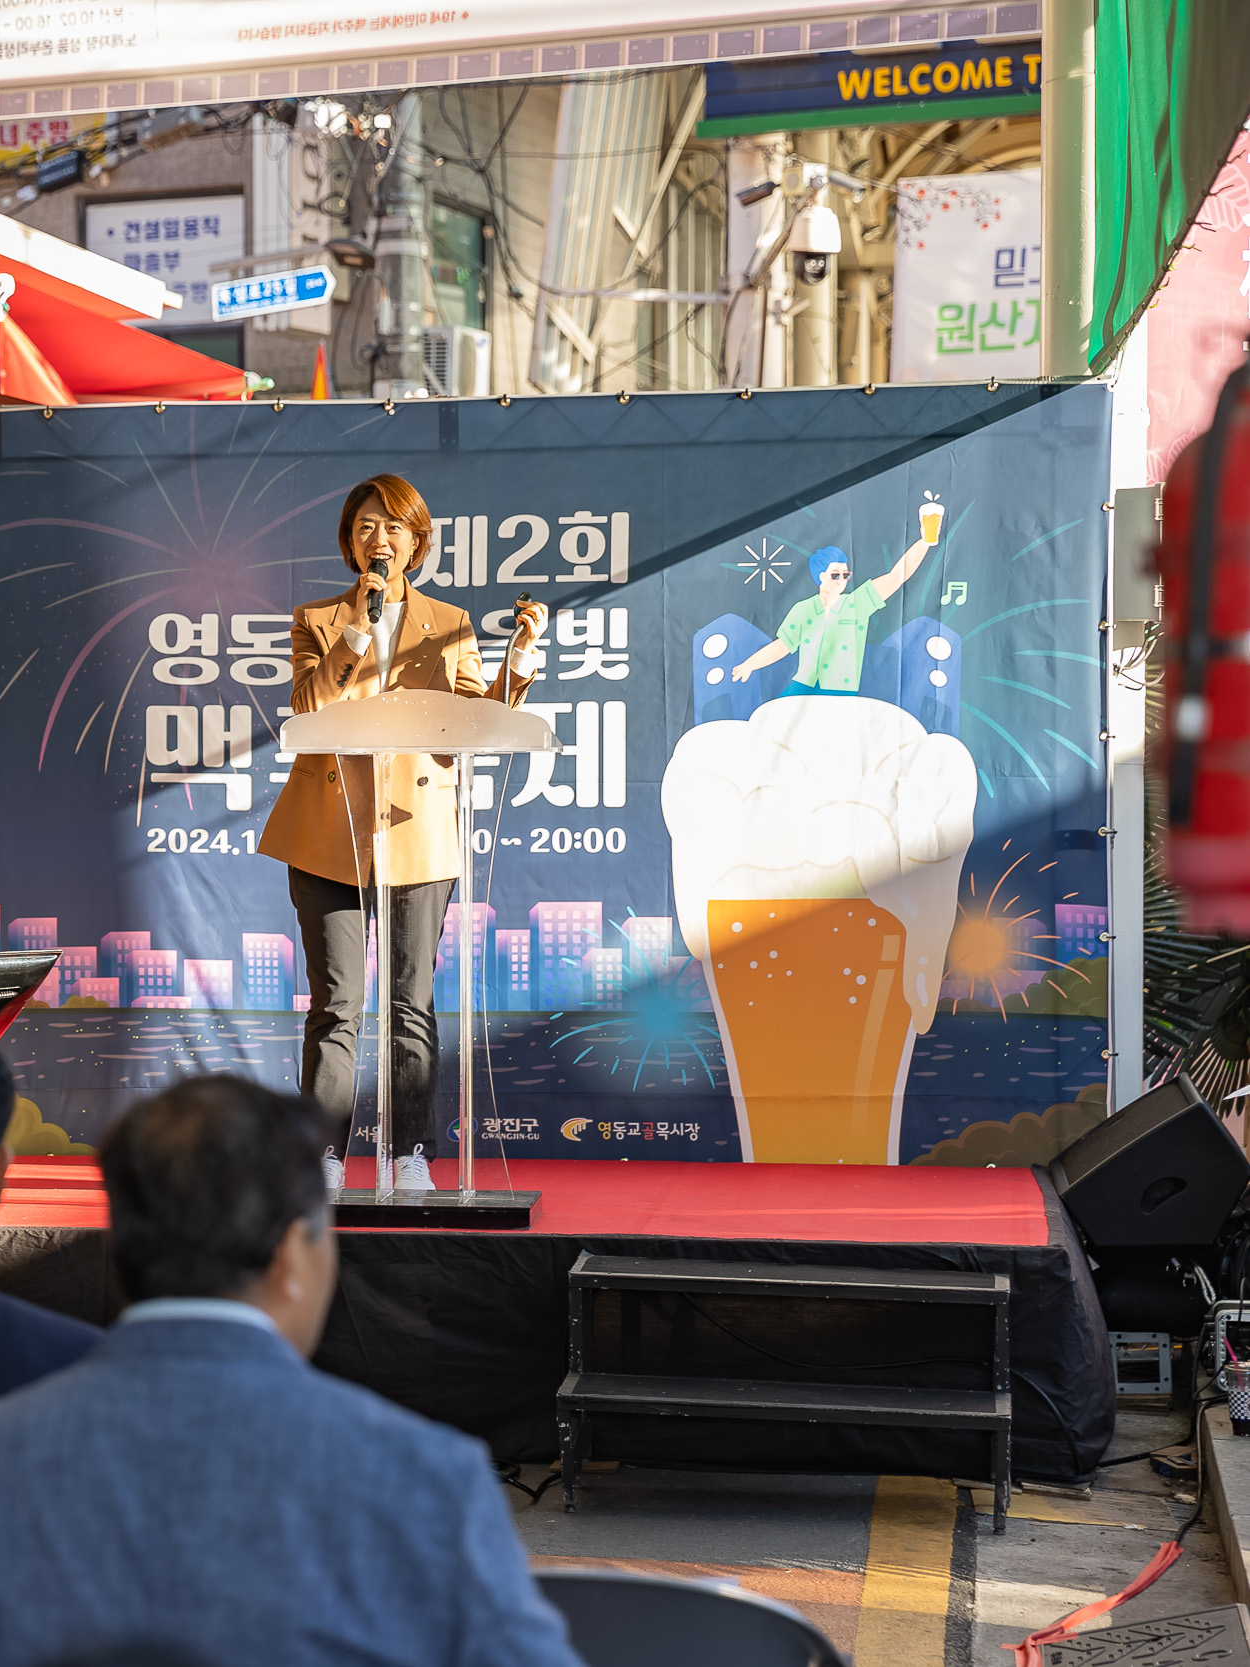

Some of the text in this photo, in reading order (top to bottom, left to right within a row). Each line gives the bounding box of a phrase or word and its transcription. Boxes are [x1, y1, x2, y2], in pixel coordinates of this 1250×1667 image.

[837, 56, 1013, 101] WELCOME
[411, 511, 630, 588] 제2회
[148, 613, 294, 686] 영동
[146, 827, 257, 856] 2024.1
[481, 1132, 540, 1141] GWANGJIN-GU
[482, 1117, 540, 1133] 광진구
[597, 1121, 701, 1142] 영동교골목시장
